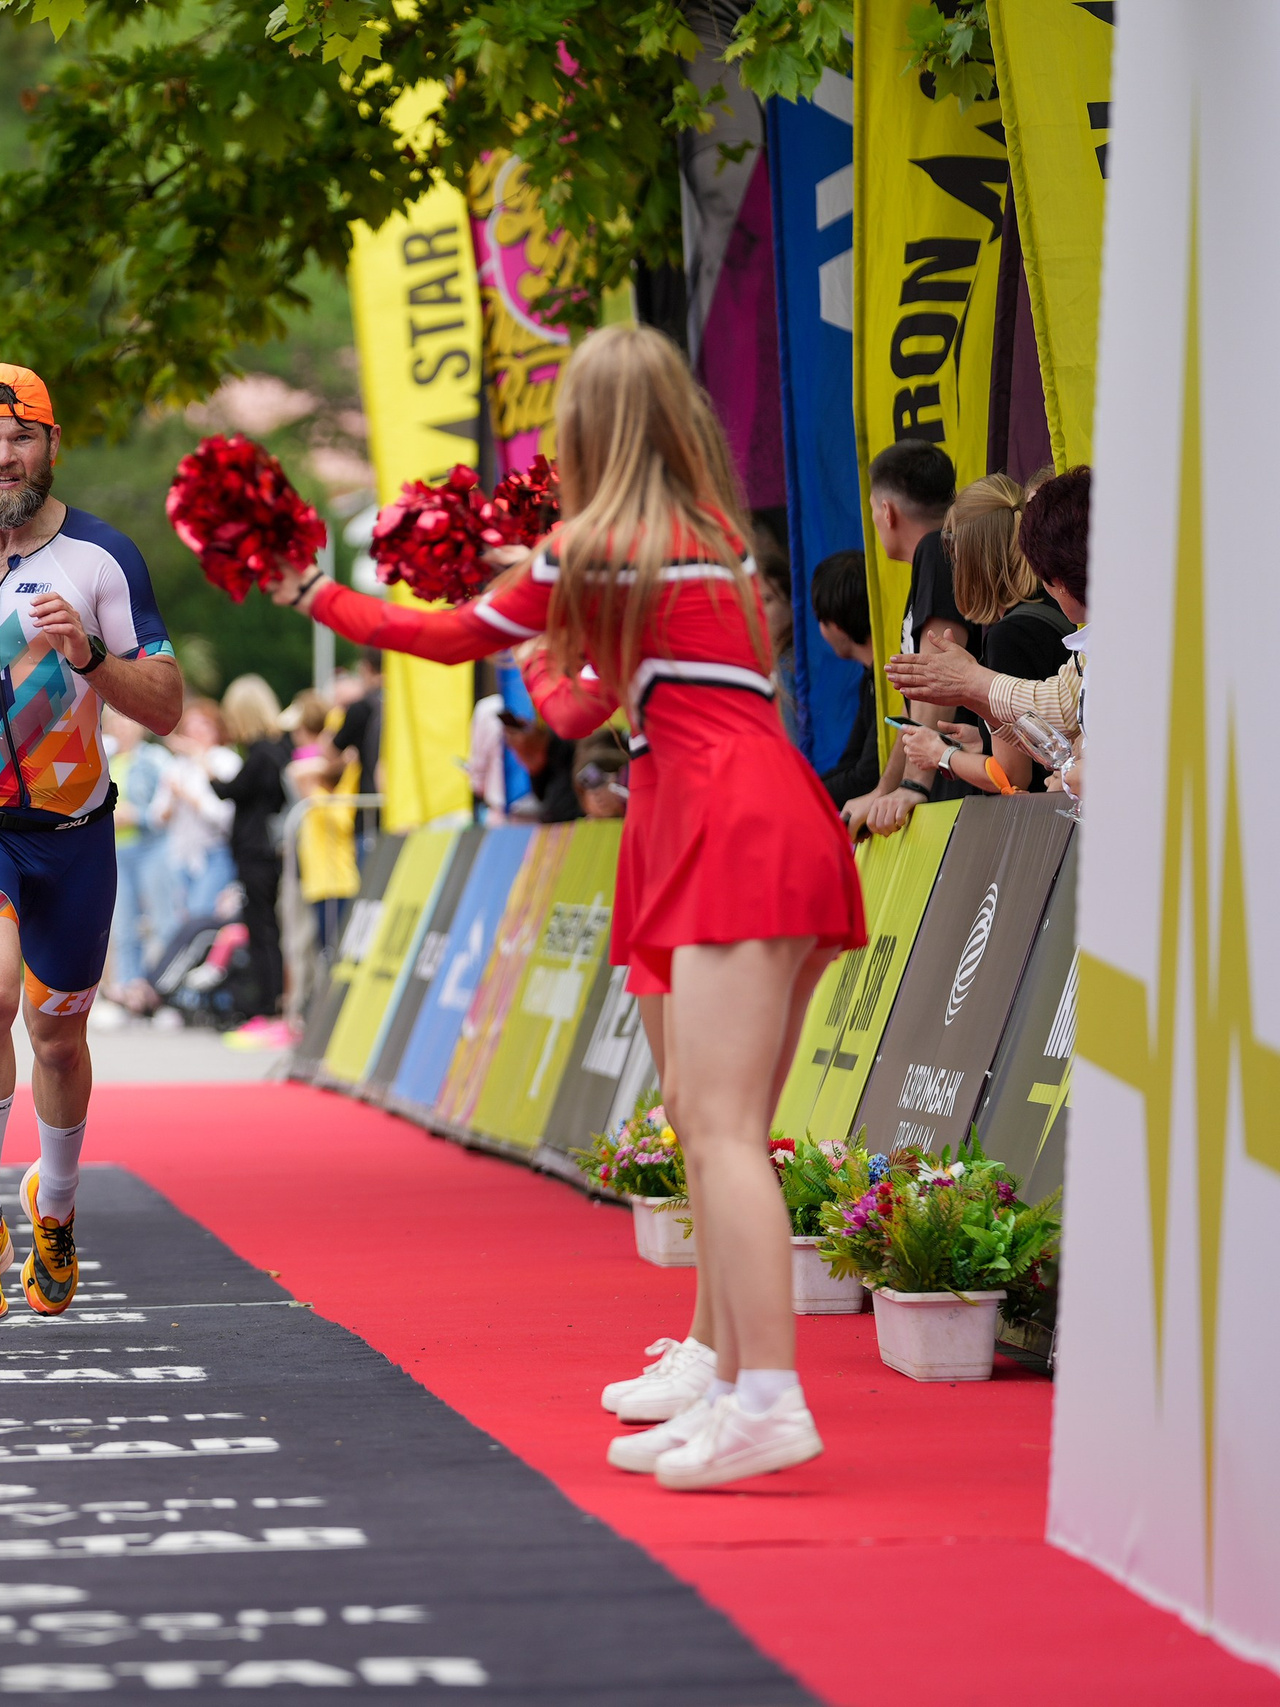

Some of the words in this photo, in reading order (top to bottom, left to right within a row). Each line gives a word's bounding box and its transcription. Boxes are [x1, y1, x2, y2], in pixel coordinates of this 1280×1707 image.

[403, 225, 470, 385] STAR
[55, 816, 89, 831] 2XU
[849, 934, 897, 1031] STAR
[1043, 944, 1080, 1059] IRO
[897, 1063, 965, 1118] ГАЗПРОМБАНК
